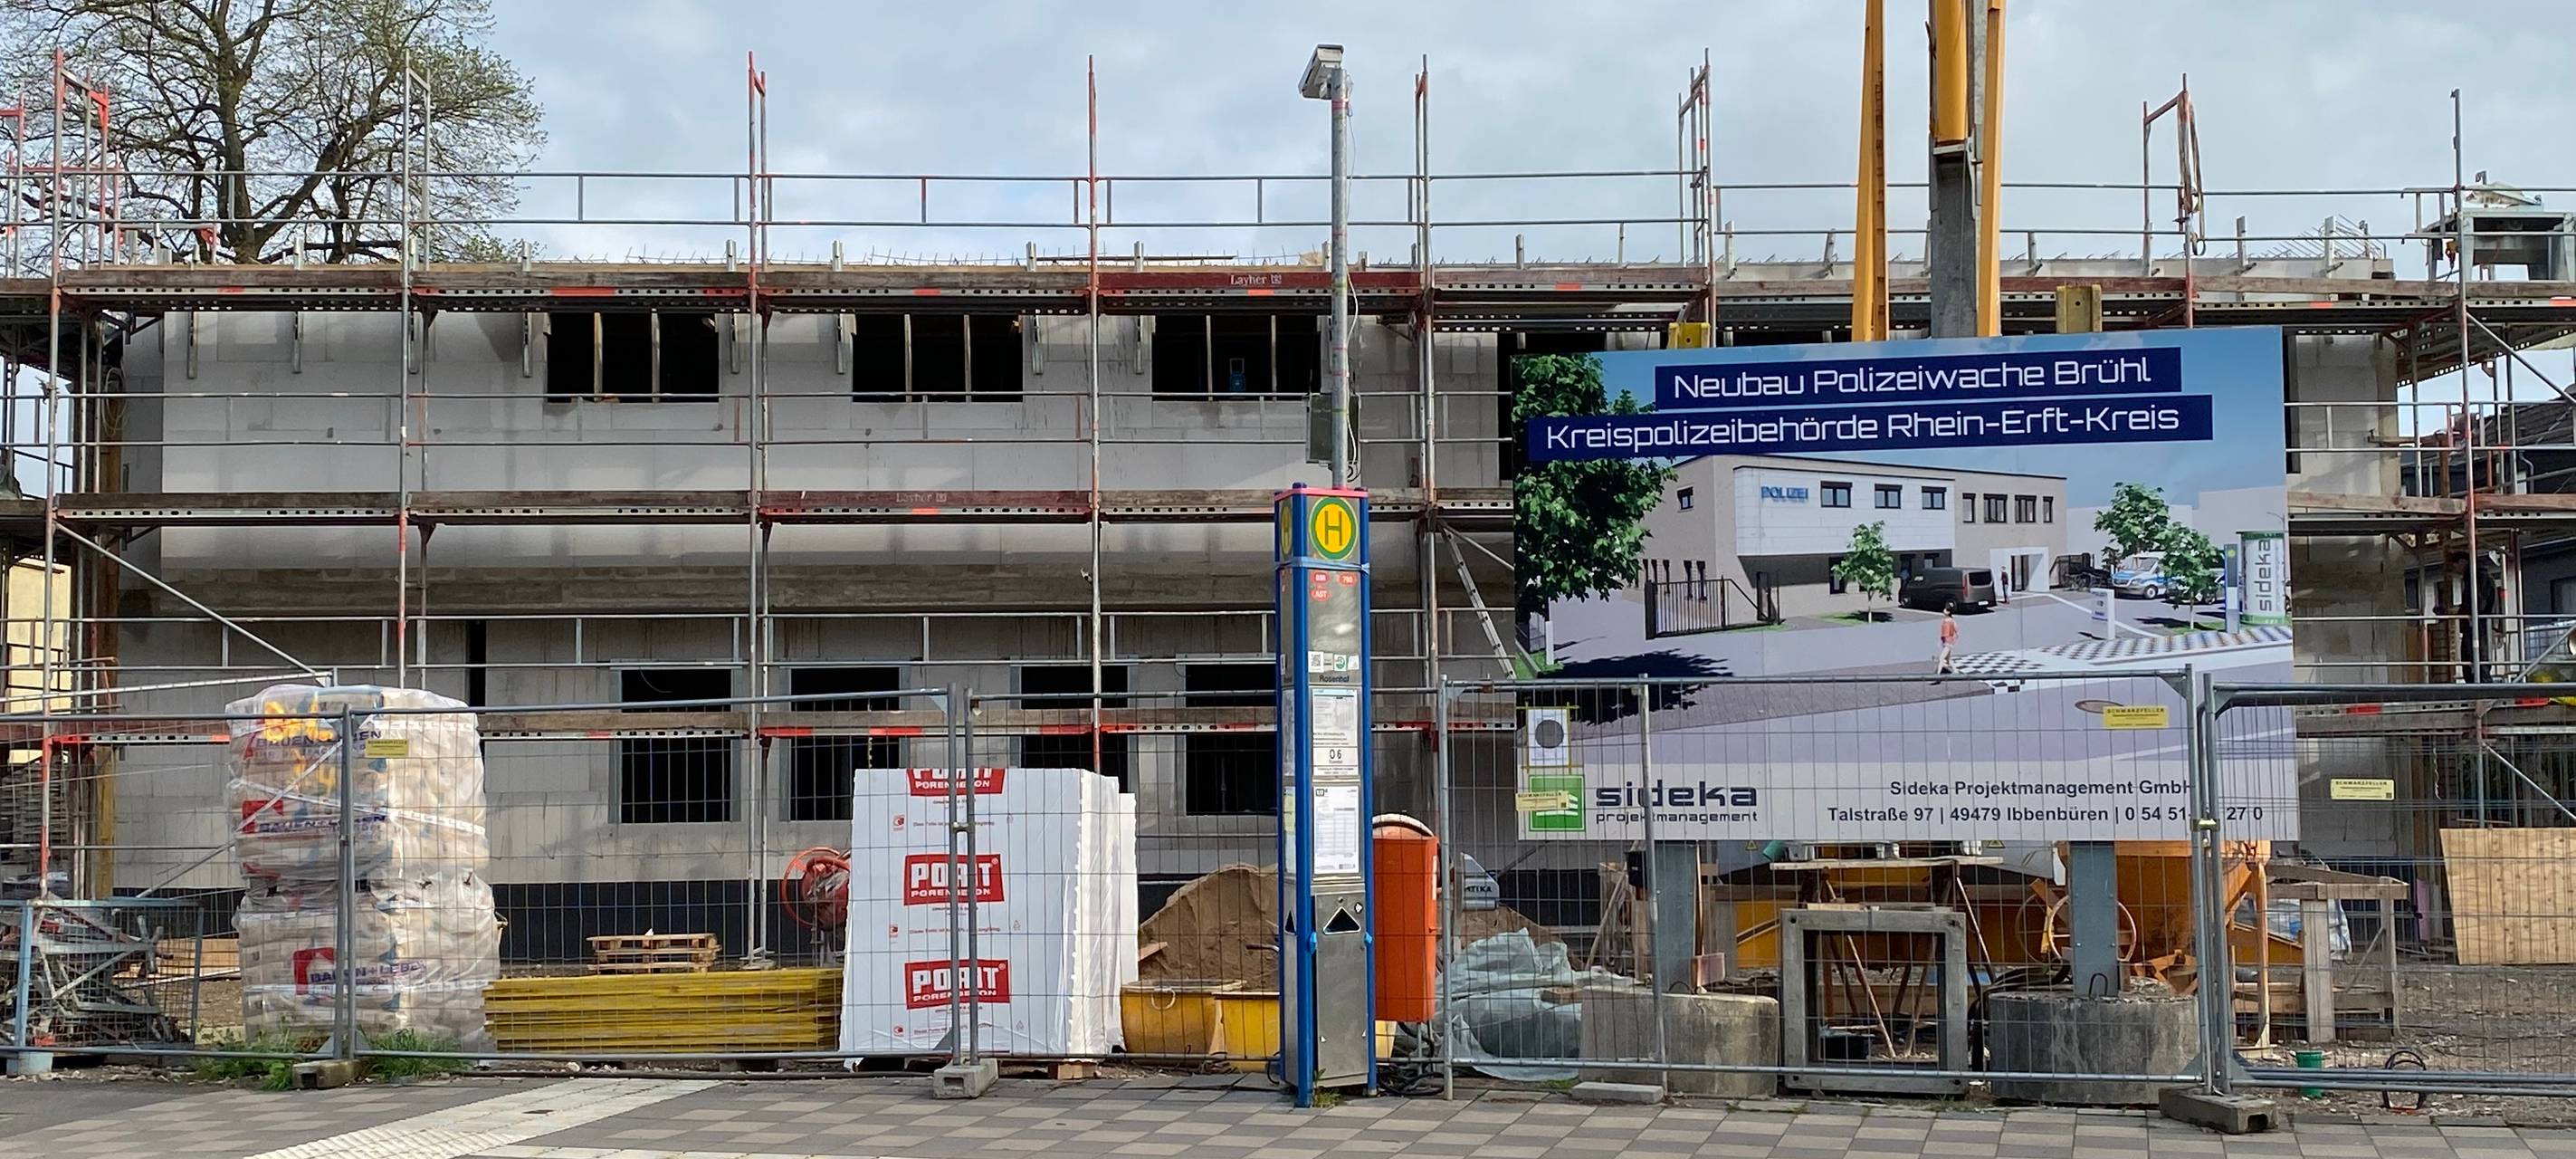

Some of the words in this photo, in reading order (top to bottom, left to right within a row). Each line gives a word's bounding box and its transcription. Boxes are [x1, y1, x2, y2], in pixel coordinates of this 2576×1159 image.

[1231, 274, 1267, 286] Layher
[1674, 371, 1805, 398] Neubau
[1814, 361, 2046, 395] Polizeiwache
[2055, 357, 2151, 385] Brühl
[1547, 414, 1879, 454] Kreispolizeibehörde
[1887, 404, 2180, 439] Rhein-Erft-Kreis
[1760, 485, 1808, 500] POLIZEI
[1324, 510, 1343, 546] H
[2253, 539, 2273, 612] sideka
[914, 780, 991, 789] PORENEON
[1596, 779, 1758, 807] sideka
[1890, 781, 1949, 795] Sideka
[1954, 780, 2133, 799] Projektmanagement
[1827, 807, 1908, 821] Talstraße
[1913, 807, 1933, 821] 97
[1949, 807, 2001, 821] 49479
[2007, 805, 2109, 821] Ibbenbüren
[2125, 807, 2135, 820] 0
[2142, 807, 2161, 820] 54
[2226, 807, 2247, 820] 27
[2253, 807, 2263, 820] 0
[911, 888, 992, 897] PORENEON
[912, 989, 997, 1002] POREEON
